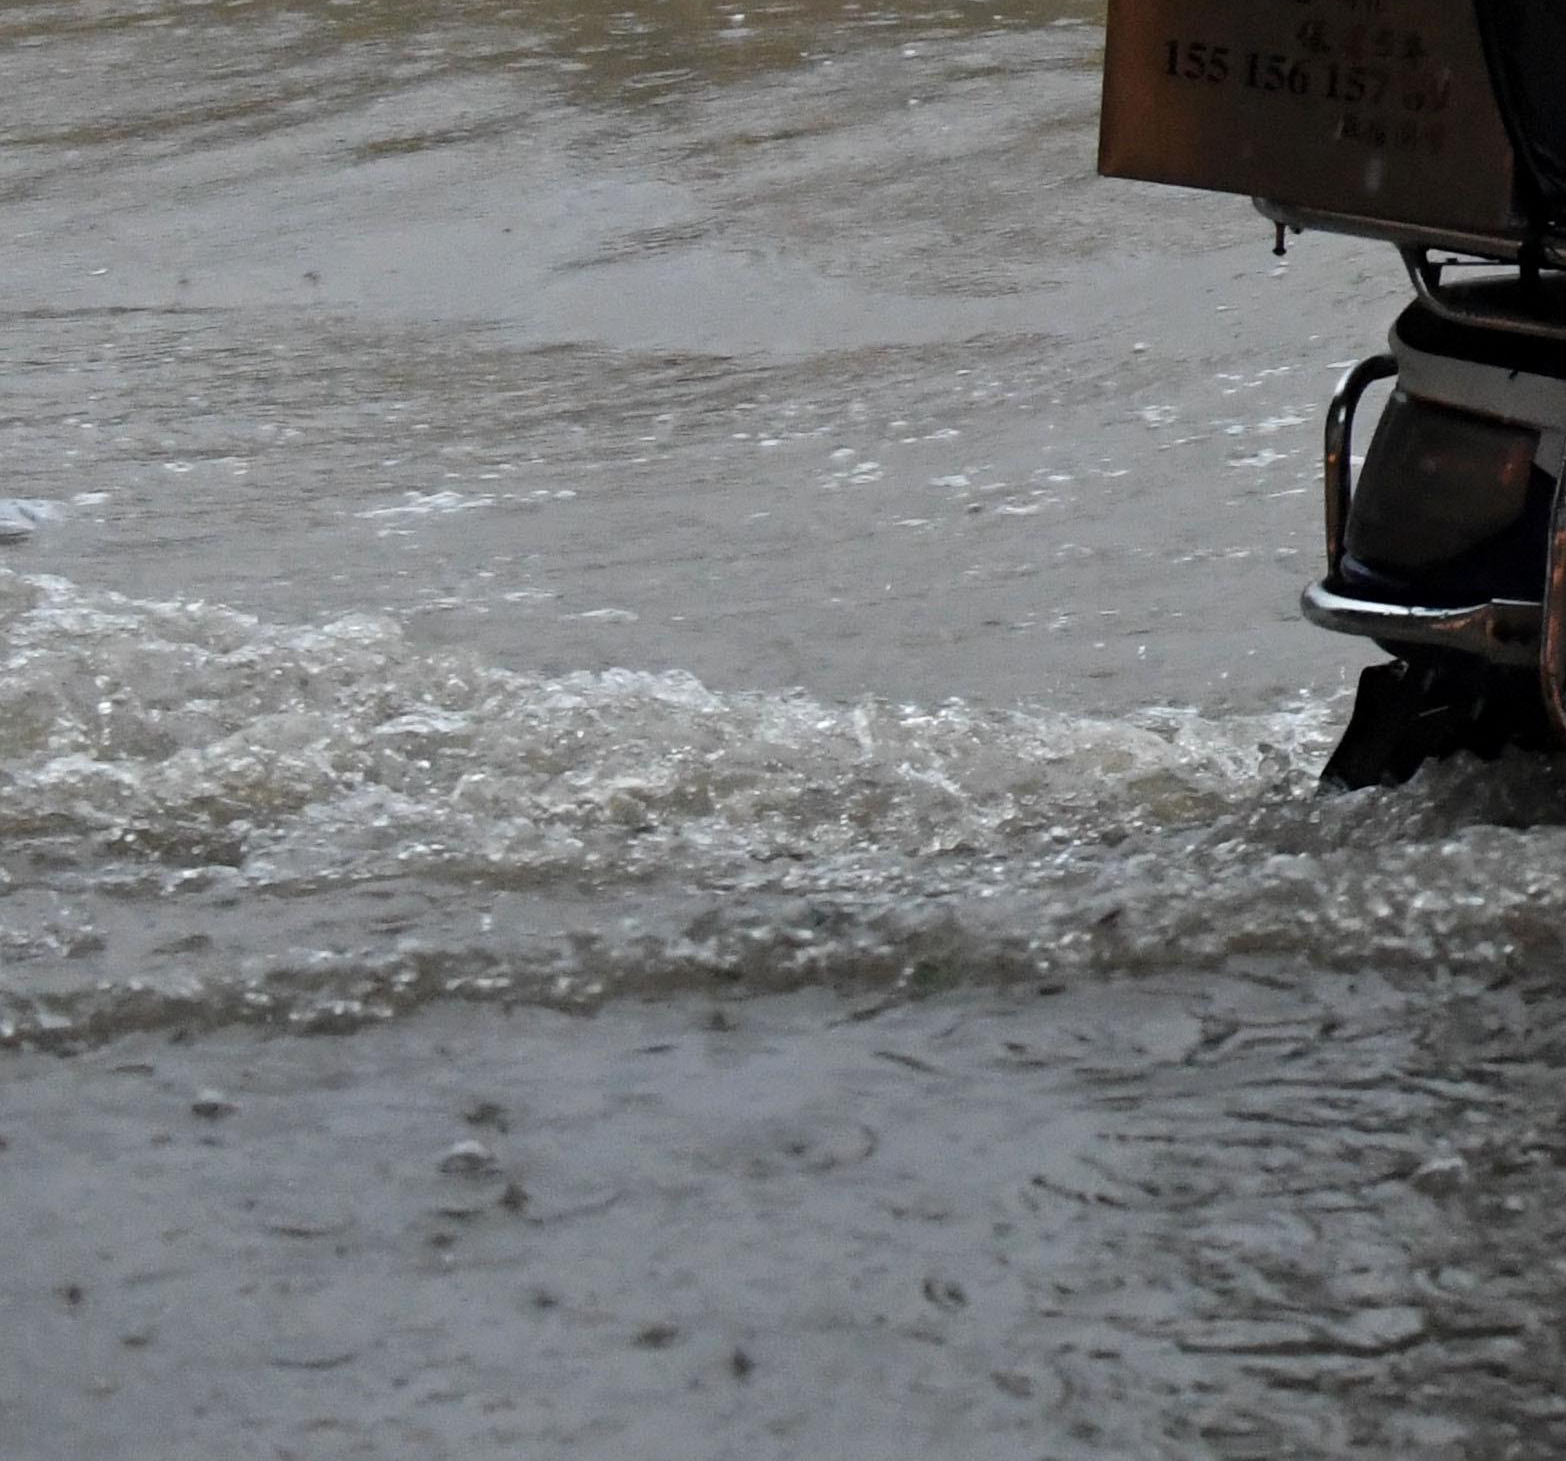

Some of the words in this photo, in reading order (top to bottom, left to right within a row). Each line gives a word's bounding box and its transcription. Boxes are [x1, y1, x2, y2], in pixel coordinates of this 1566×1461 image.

[1164, 39, 1230, 85] 155
[1244, 51, 1310, 96] 156
[1325, 61, 1390, 105] 157
